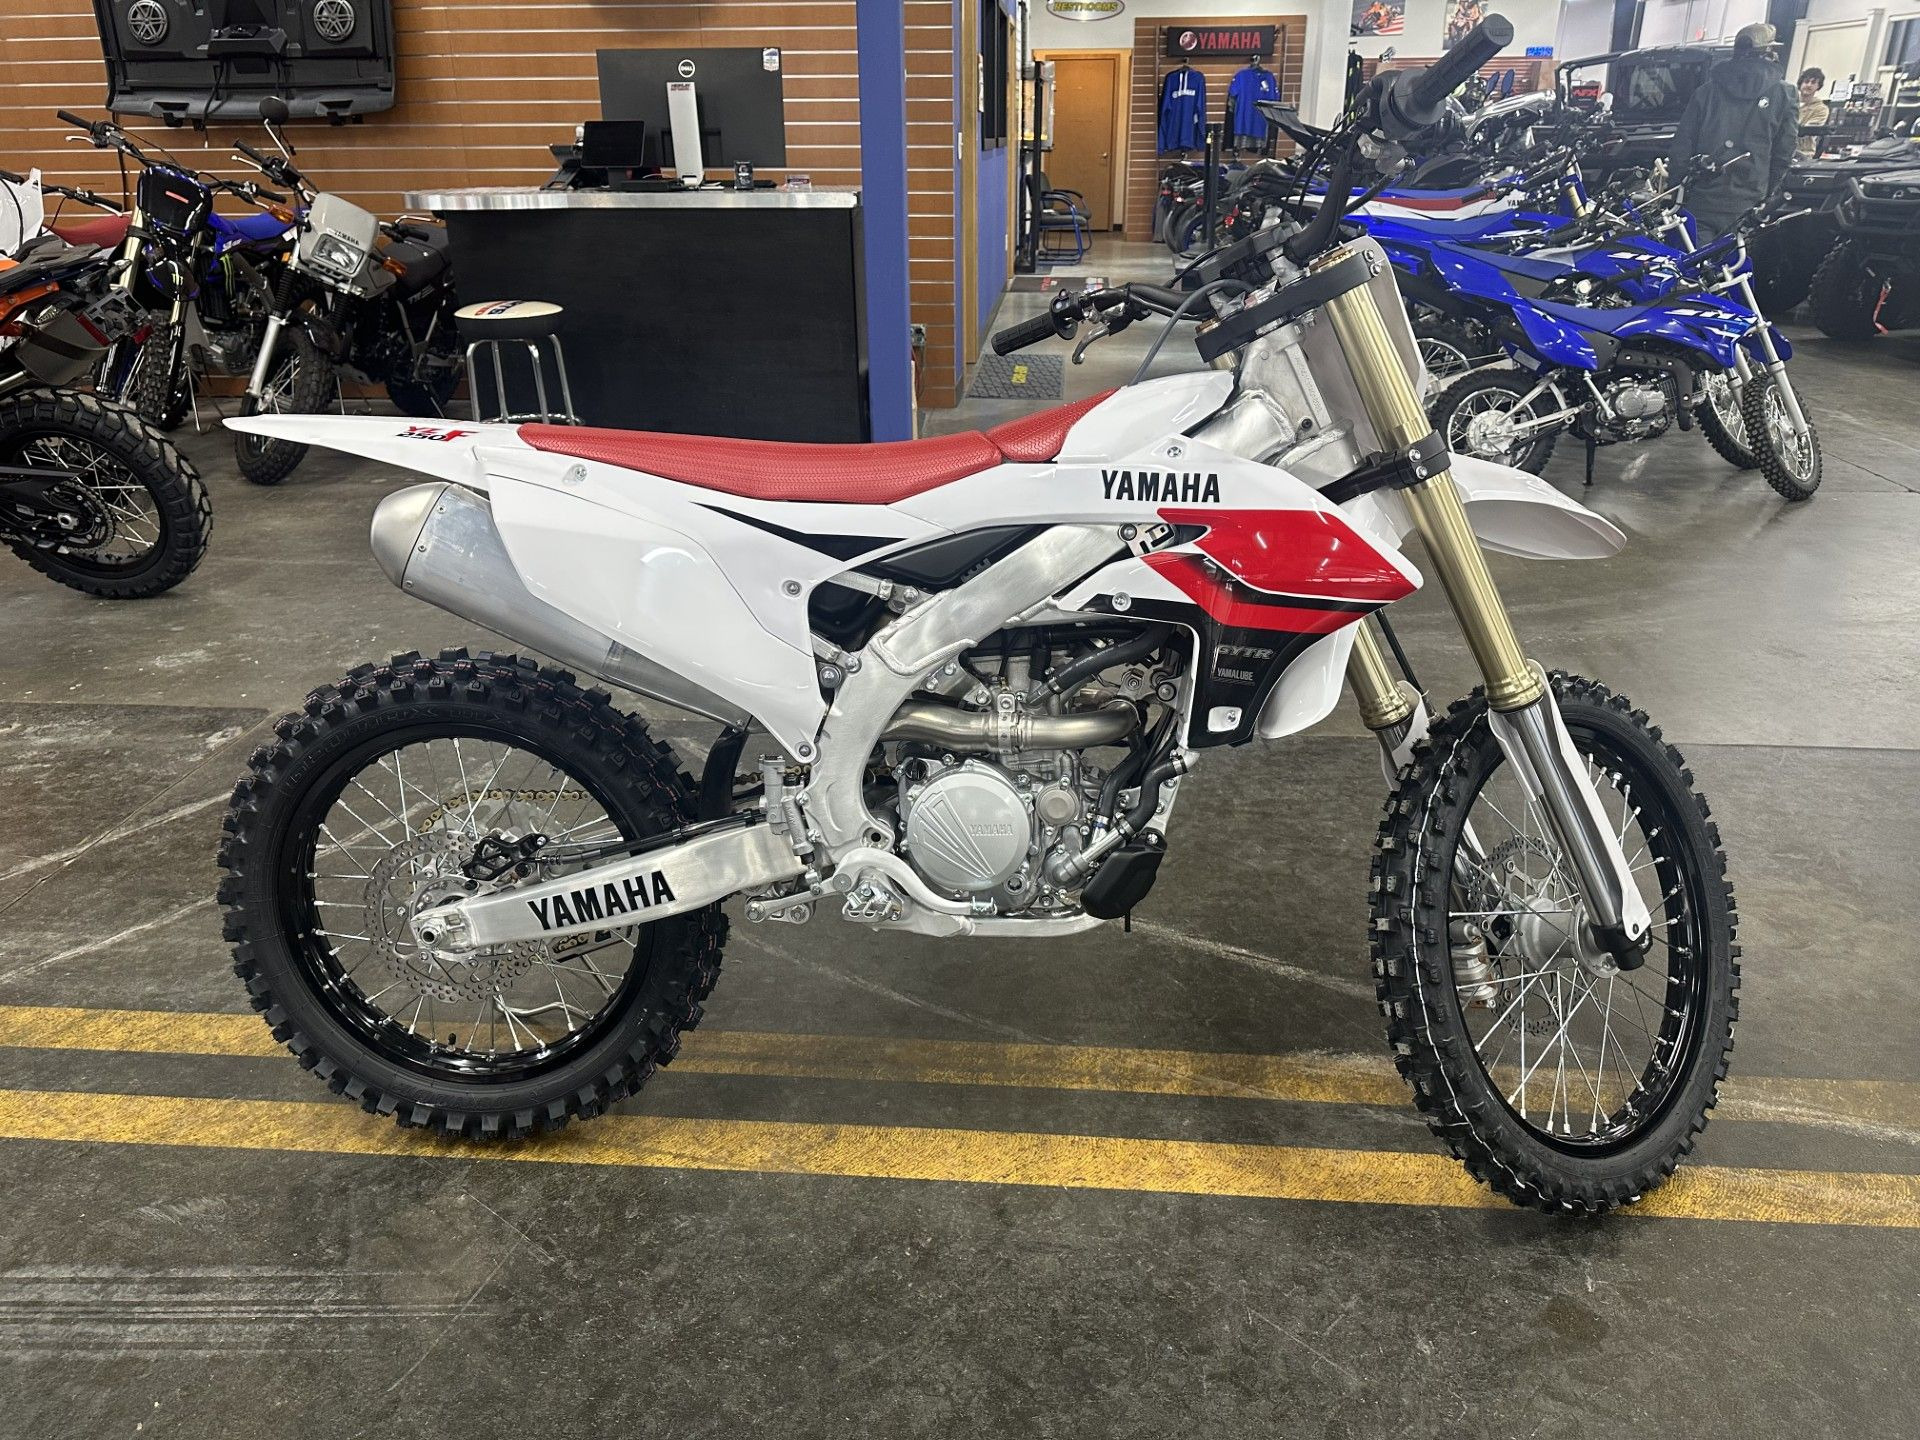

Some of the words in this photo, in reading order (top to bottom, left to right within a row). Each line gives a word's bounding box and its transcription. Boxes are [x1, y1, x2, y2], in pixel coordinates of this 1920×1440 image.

[1054, 2, 1118, 11] RESTROOMS
[1199, 31, 1262, 50] YAMAHA
[1101, 469, 1220, 503] YAMAHA
[1218, 644, 1274, 660] GYTR
[1217, 667, 1254, 681] YAMALUBE
[969, 823, 1014, 837] YAMAHA
[527, 870, 677, 931] YAMAHA
